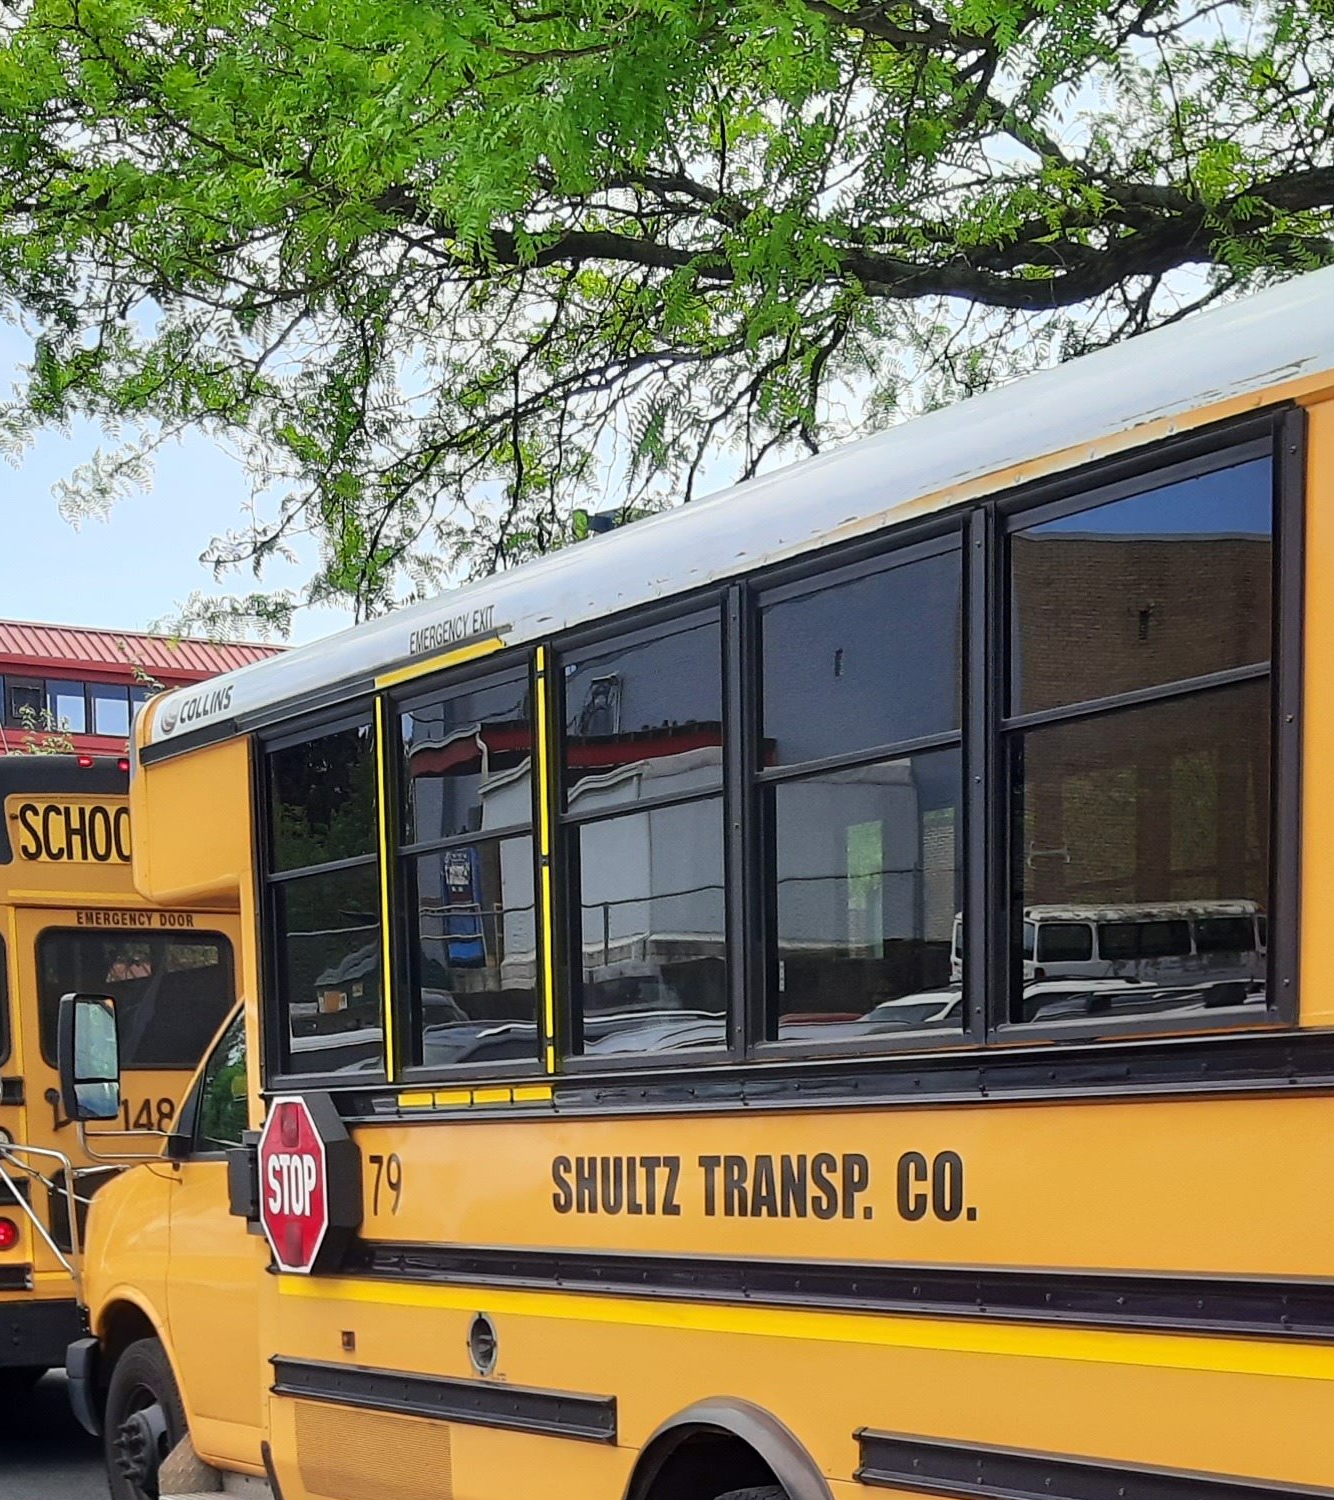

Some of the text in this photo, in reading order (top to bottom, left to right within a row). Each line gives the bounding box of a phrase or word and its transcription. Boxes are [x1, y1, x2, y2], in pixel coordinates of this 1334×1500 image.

[410, 604, 495, 655] EMERGENCY EXIT
[179, 684, 235, 725] COLLINS
[19, 803, 132, 863] SCHOO
[76, 910, 195, 928] EMERGENCY DOOR
[121, 1096, 175, 1132] 148
[267, 1153, 318, 1217] STOP
[369, 1152, 402, 1217] 79
[551, 1150, 977, 1222] SHULTZ TRANSP. CO.
